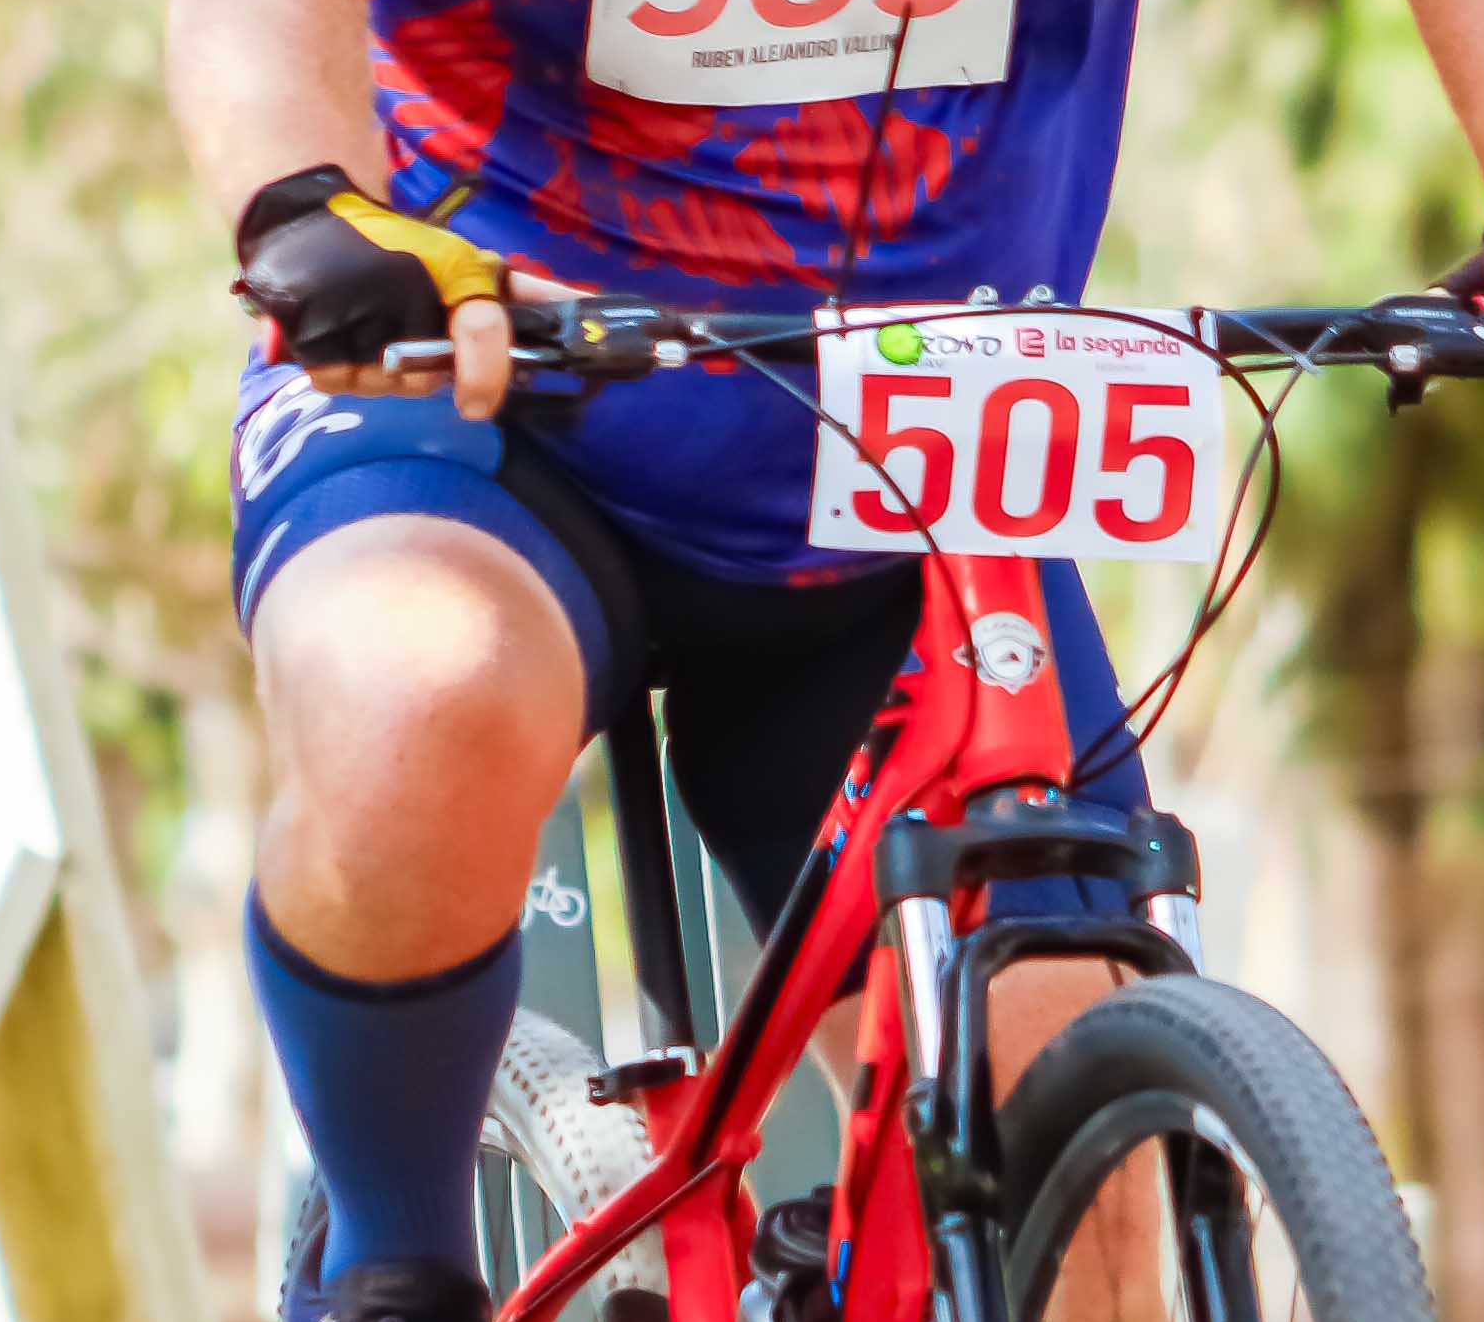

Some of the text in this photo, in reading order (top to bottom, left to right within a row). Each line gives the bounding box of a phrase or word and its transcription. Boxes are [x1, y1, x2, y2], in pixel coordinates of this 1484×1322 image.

[748, 38, 837, 64] ALEJANDRO
[1055, 329, 1075, 353] la
[1082, 333, 1181, 358] segunda
[851, 373, 1195, 543] 505
